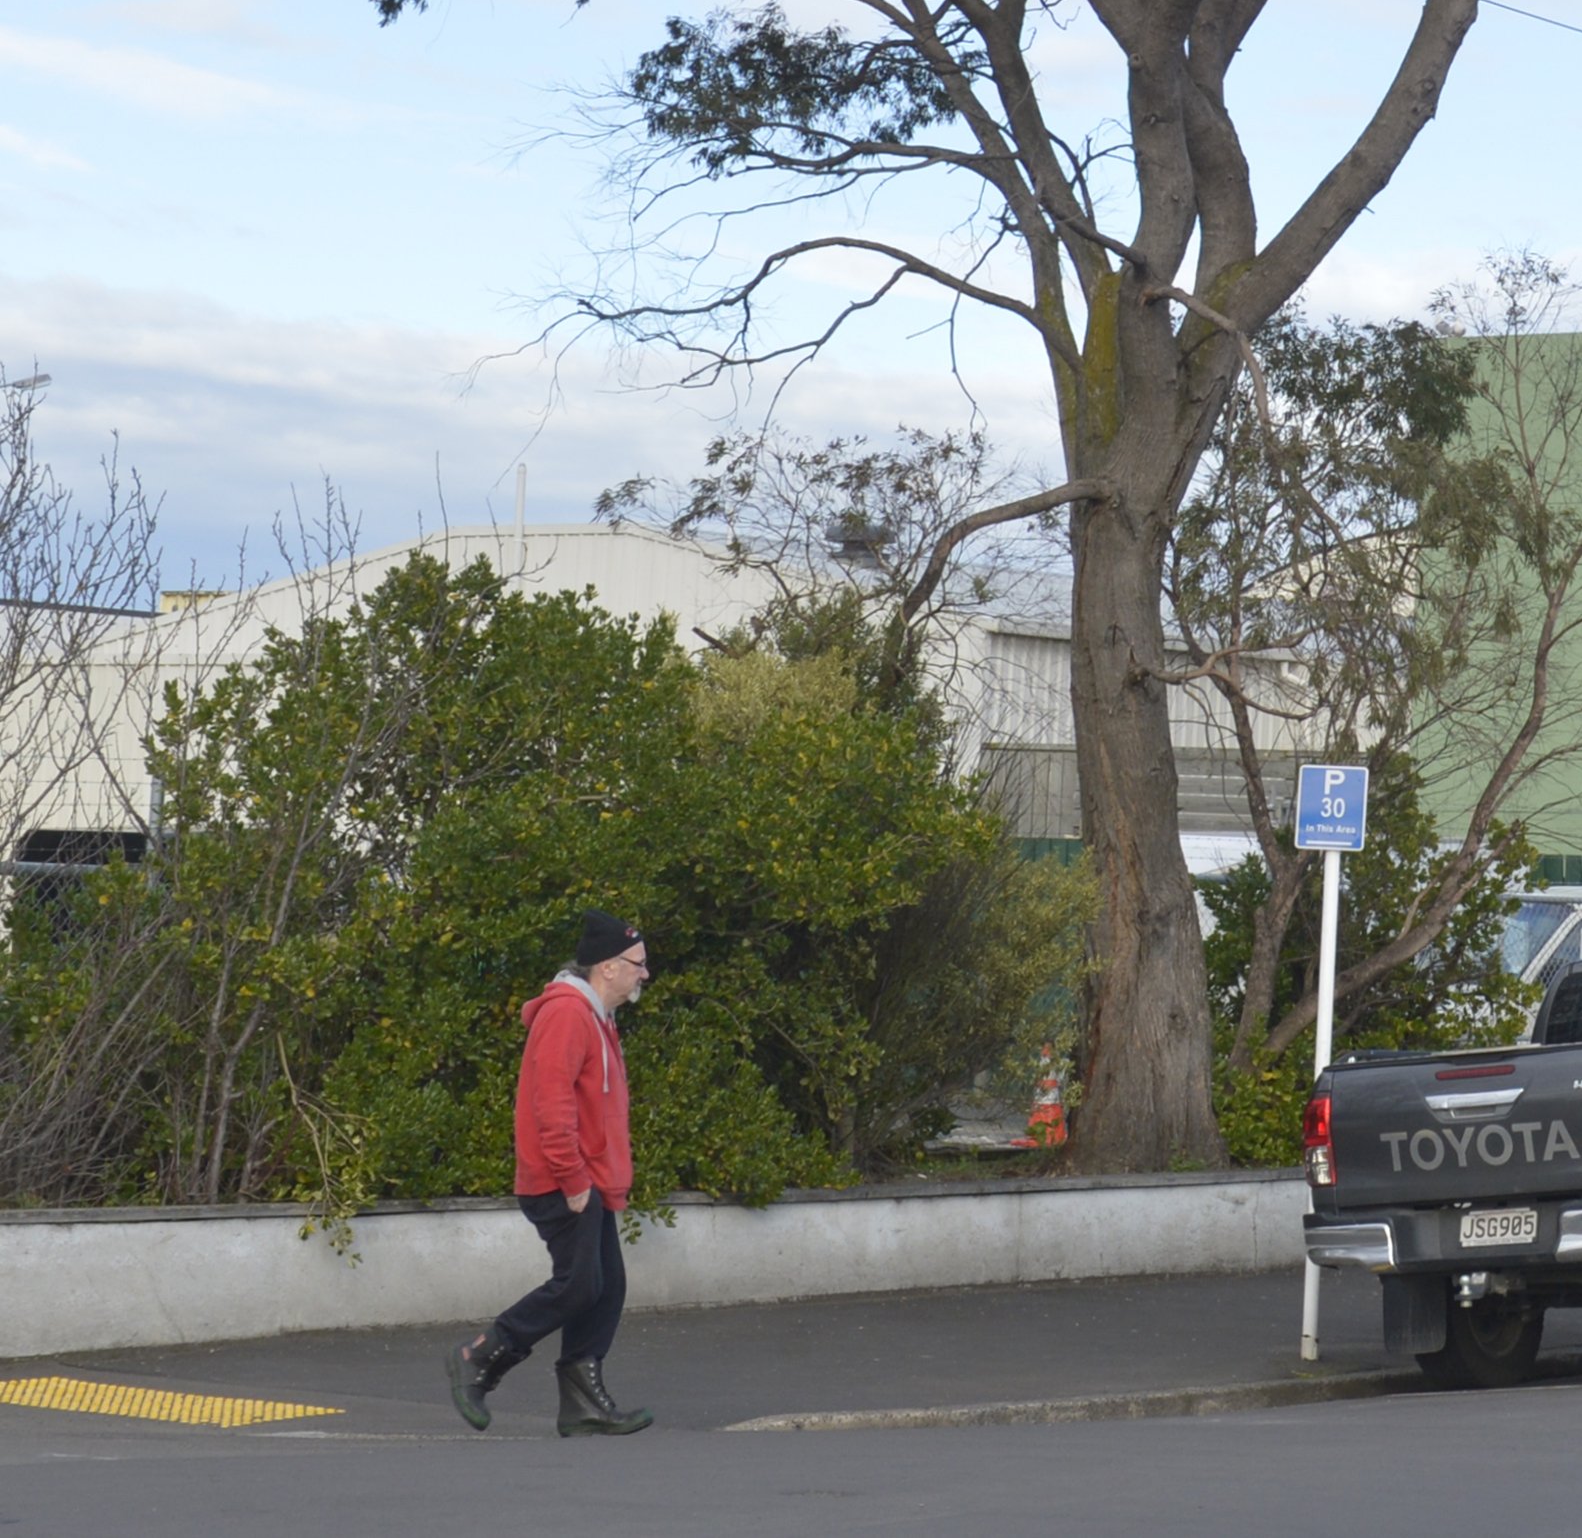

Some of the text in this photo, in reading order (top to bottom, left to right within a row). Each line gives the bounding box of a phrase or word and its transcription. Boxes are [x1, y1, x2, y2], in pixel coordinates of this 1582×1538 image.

[1324, 769, 1346, 795] P
[1320, 797, 1346, 818] 30
[1305, 823, 1356, 834] In This Area
[1380, 1120, 1580, 1172] TOYOTA
[1463, 1214, 1535, 1239] JSG905
